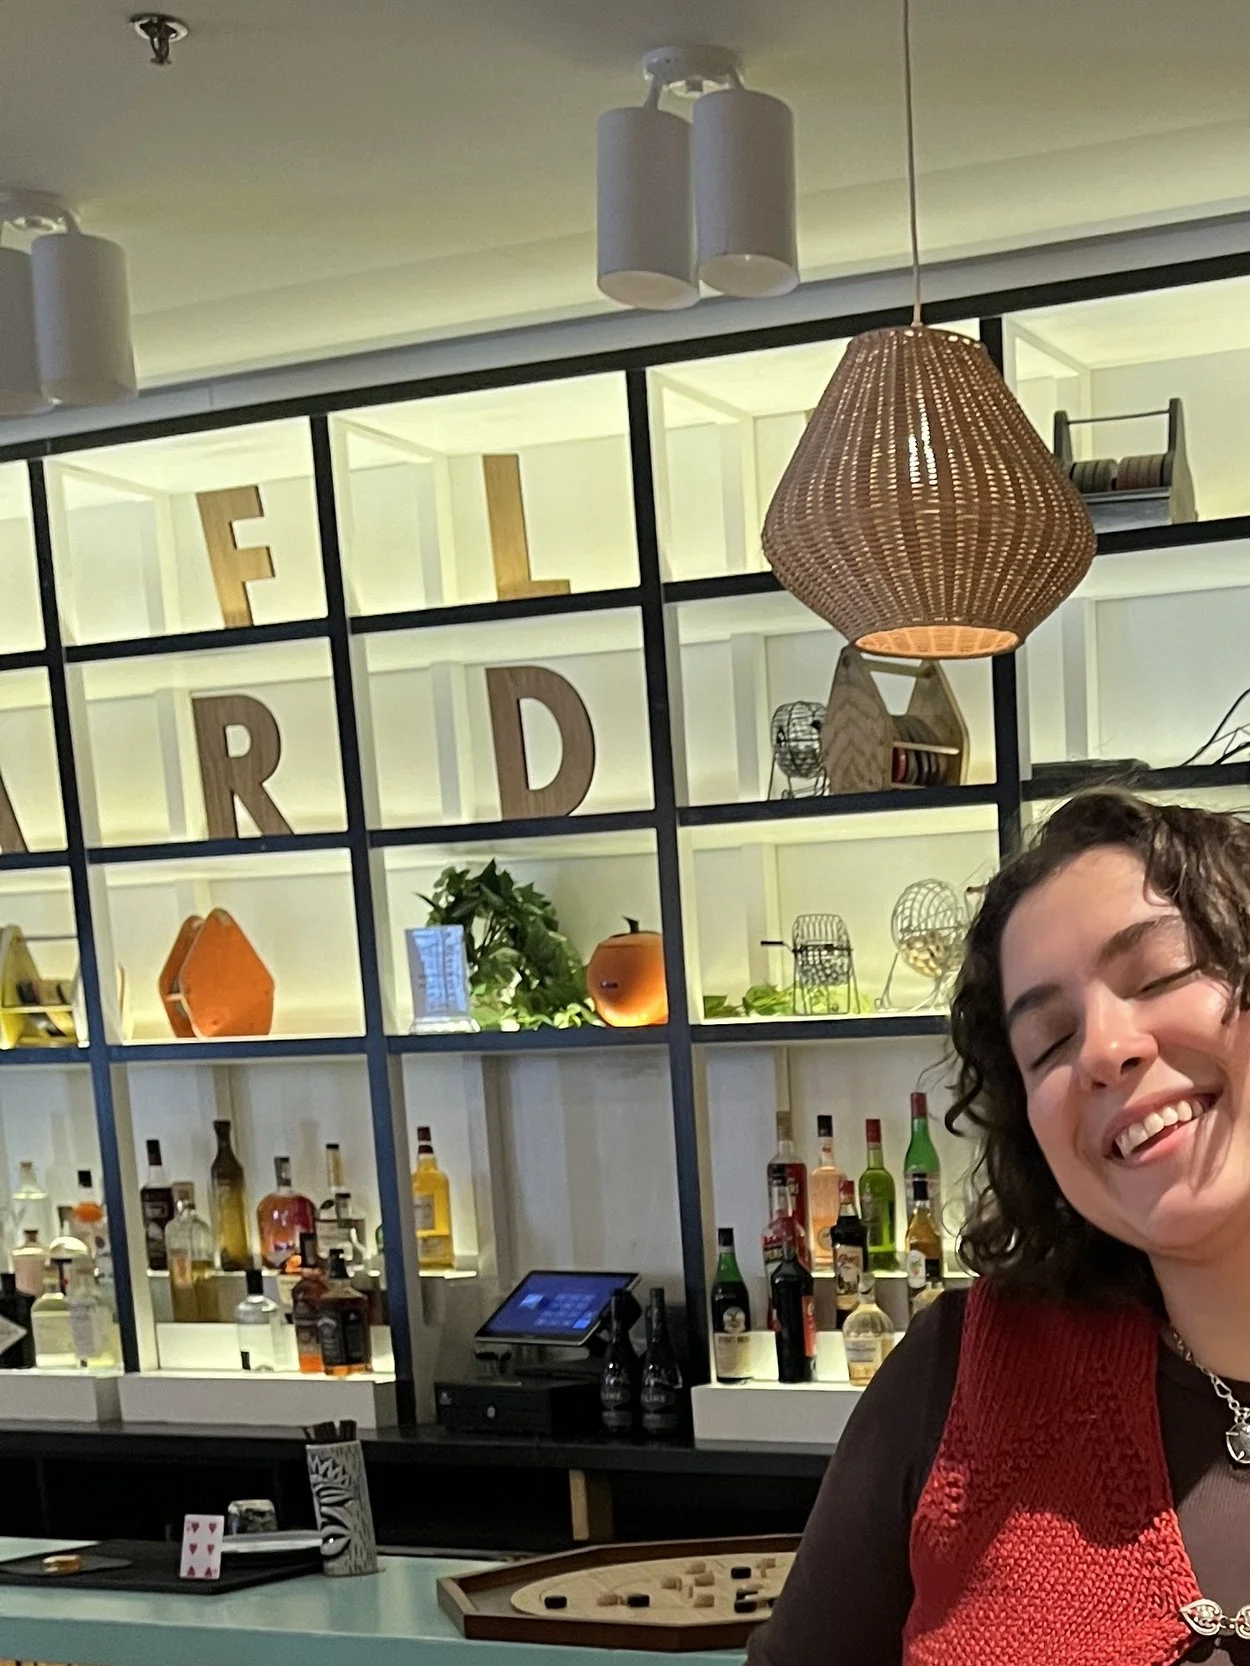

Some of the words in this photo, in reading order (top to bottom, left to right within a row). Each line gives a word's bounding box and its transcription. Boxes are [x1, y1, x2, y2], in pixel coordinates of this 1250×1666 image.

[197, 485, 275, 628] F
[483, 453, 571, 601] L
[191, 694, 294, 838] R
[486, 666, 595, 820] D
